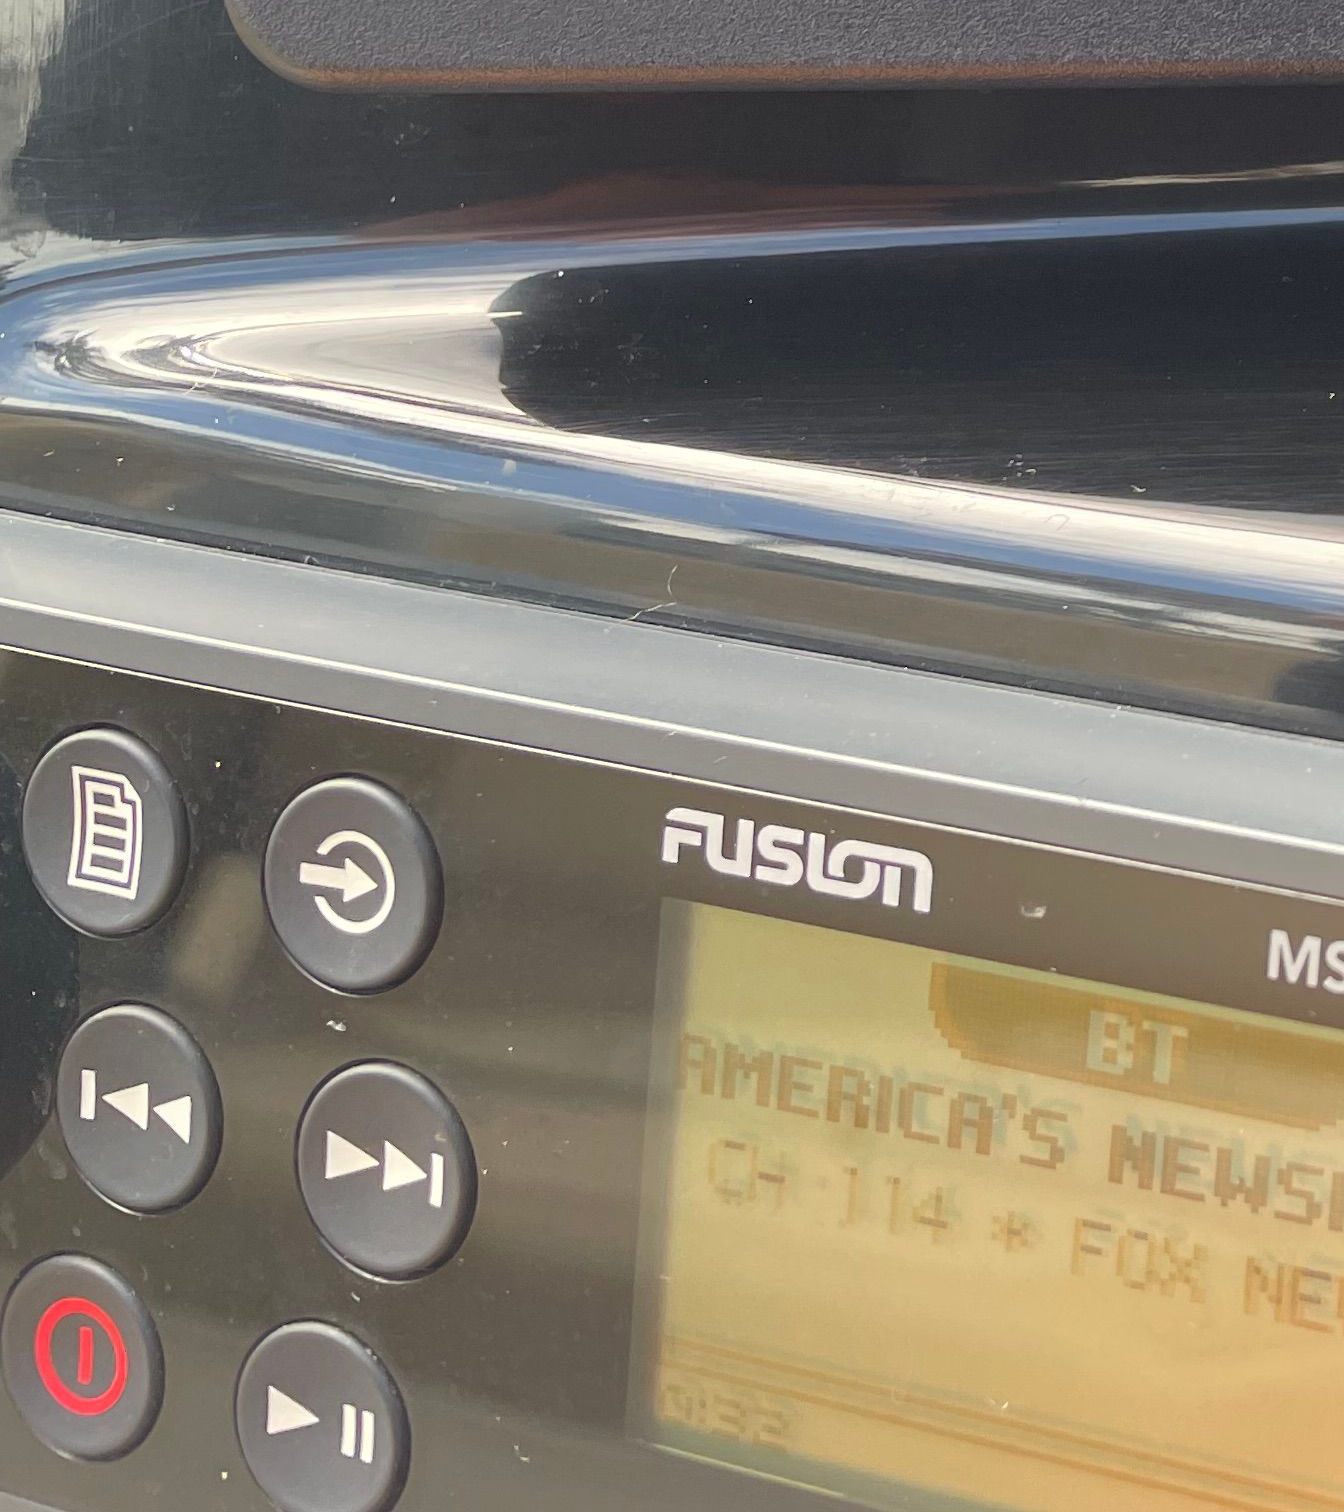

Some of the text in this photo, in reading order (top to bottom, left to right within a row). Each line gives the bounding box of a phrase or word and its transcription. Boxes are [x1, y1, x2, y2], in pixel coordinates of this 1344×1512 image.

[661, 807, 934, 914] FUSION
[678, 1033, 1069, 1170] AMERICA'S
[1085, 1009, 1189, 1086] BT
[838, 1167, 950, 1245] 114
[1071, 1216, 1205, 1304] FOX
